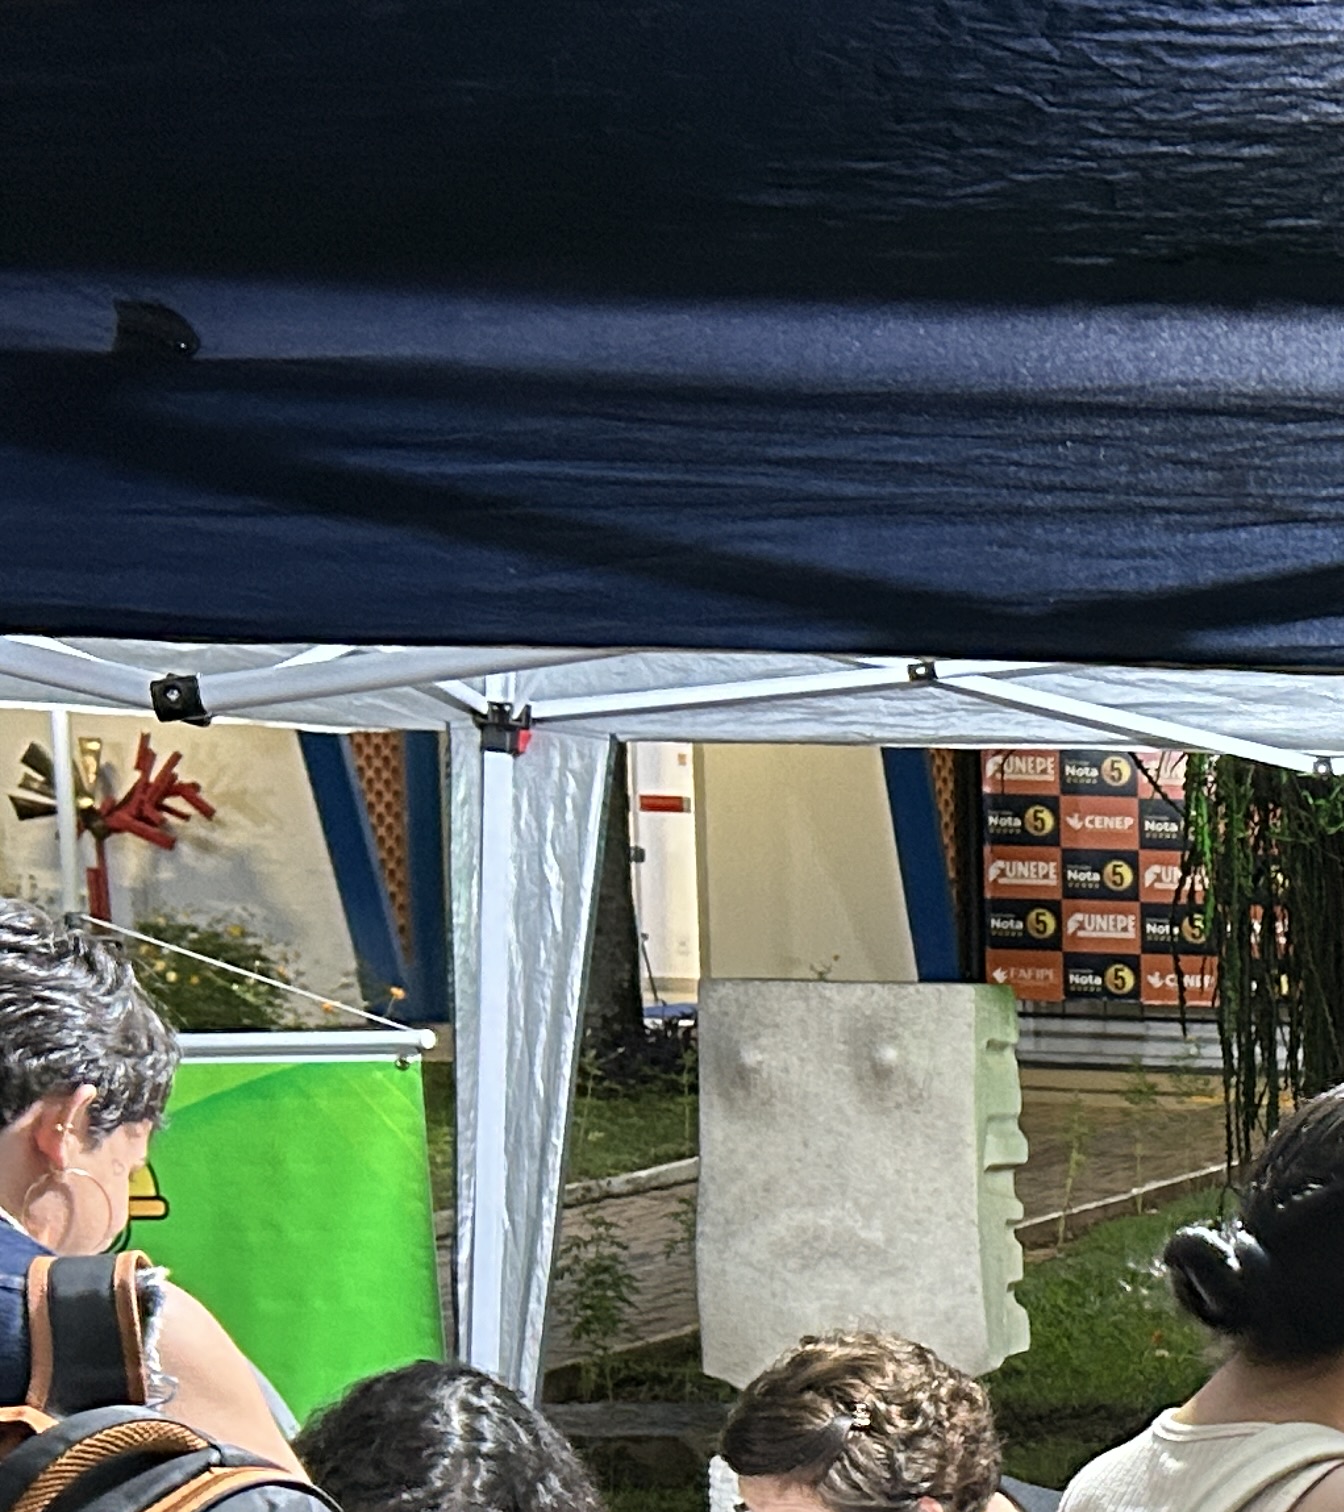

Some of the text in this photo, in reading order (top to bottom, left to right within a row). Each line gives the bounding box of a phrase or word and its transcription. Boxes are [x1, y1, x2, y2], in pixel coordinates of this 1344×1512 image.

[1065, 764, 1099, 777] Nota
[988, 816, 1022, 827] Nota
[1085, 815, 1134, 830] CENEP
[1144, 820, 1178, 832] Nota
[988, 860, 1057, 882] FUNEPE
[1067, 871, 1100, 882] Nota
[990, 918, 1024, 930] Nota
[1067, 912, 1136, 936] FUNEPE
[1069, 974, 1102, 986] Nota
